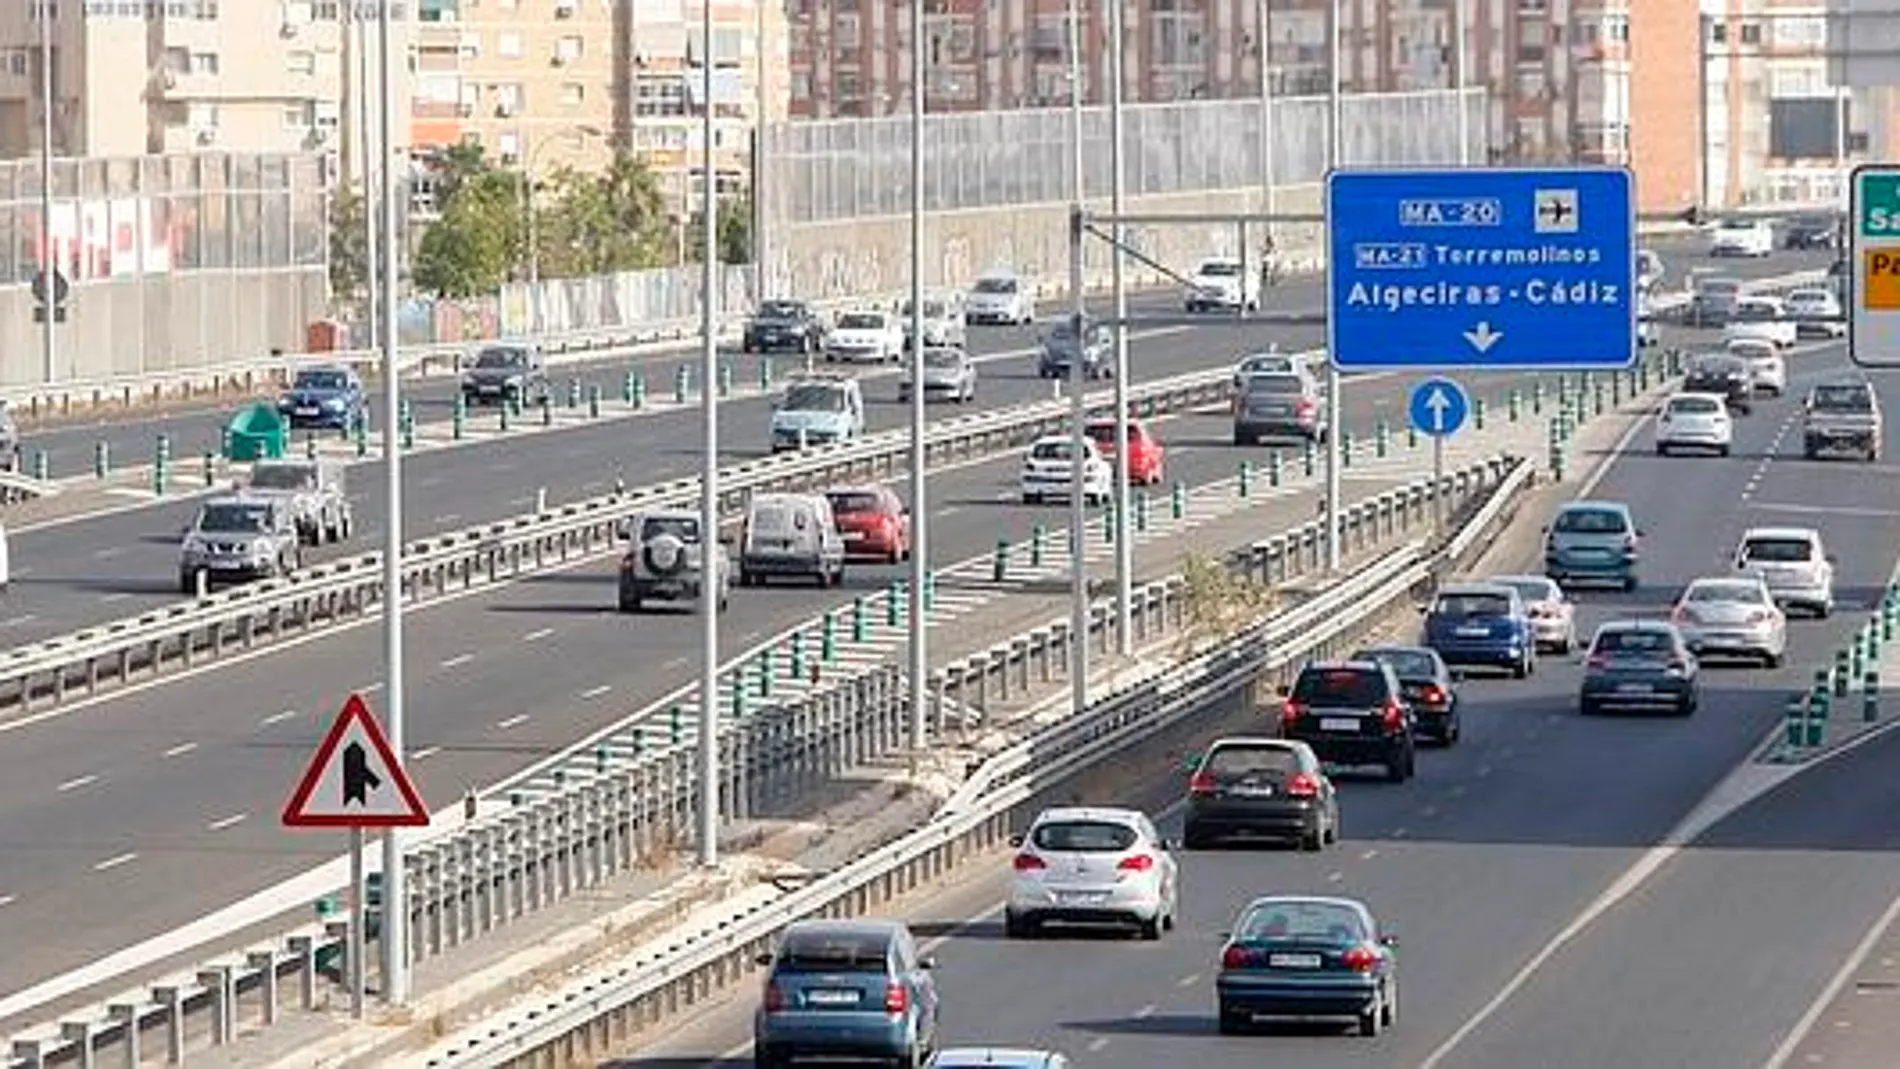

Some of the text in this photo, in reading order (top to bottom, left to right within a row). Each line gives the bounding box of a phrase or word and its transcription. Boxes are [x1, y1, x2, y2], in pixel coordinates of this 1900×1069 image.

[1404, 202, 1494, 223] MA-20
[1434, 245, 1600, 264] Torremolinos
[1348, 280, 1500, 311] Algeciras
